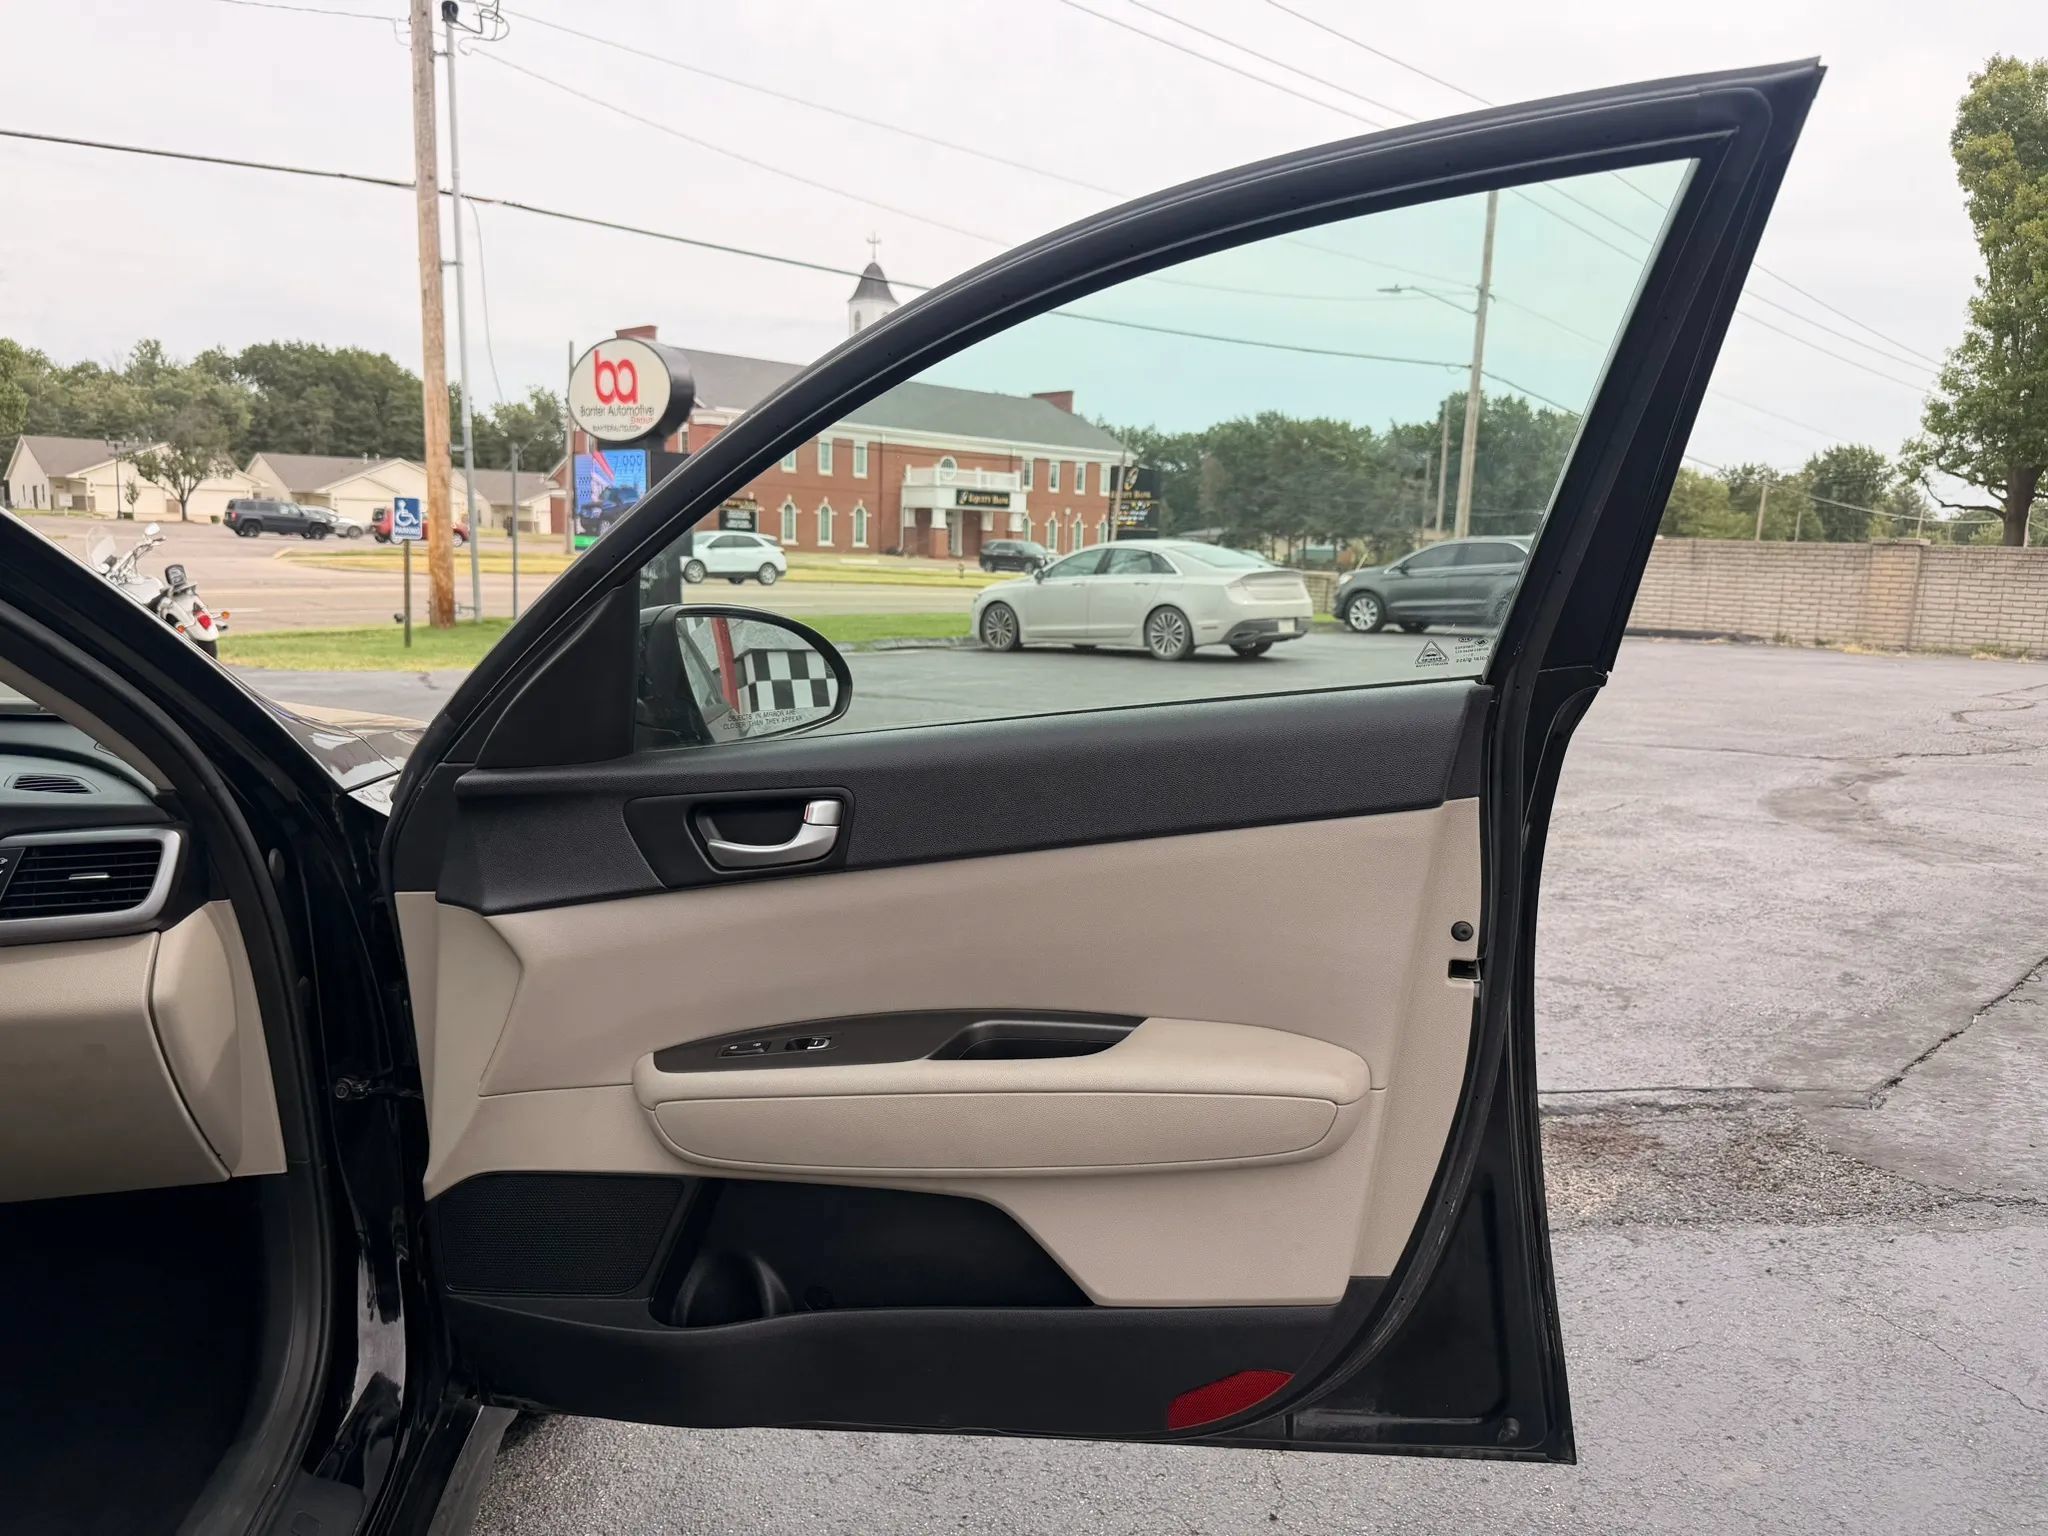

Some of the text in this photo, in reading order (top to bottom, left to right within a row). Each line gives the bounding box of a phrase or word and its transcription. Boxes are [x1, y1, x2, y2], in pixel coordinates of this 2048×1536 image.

[594, 349, 637, 405] ba
[608, 404, 654, 417] Automotive
[723, 721, 746, 730] CLOSER
